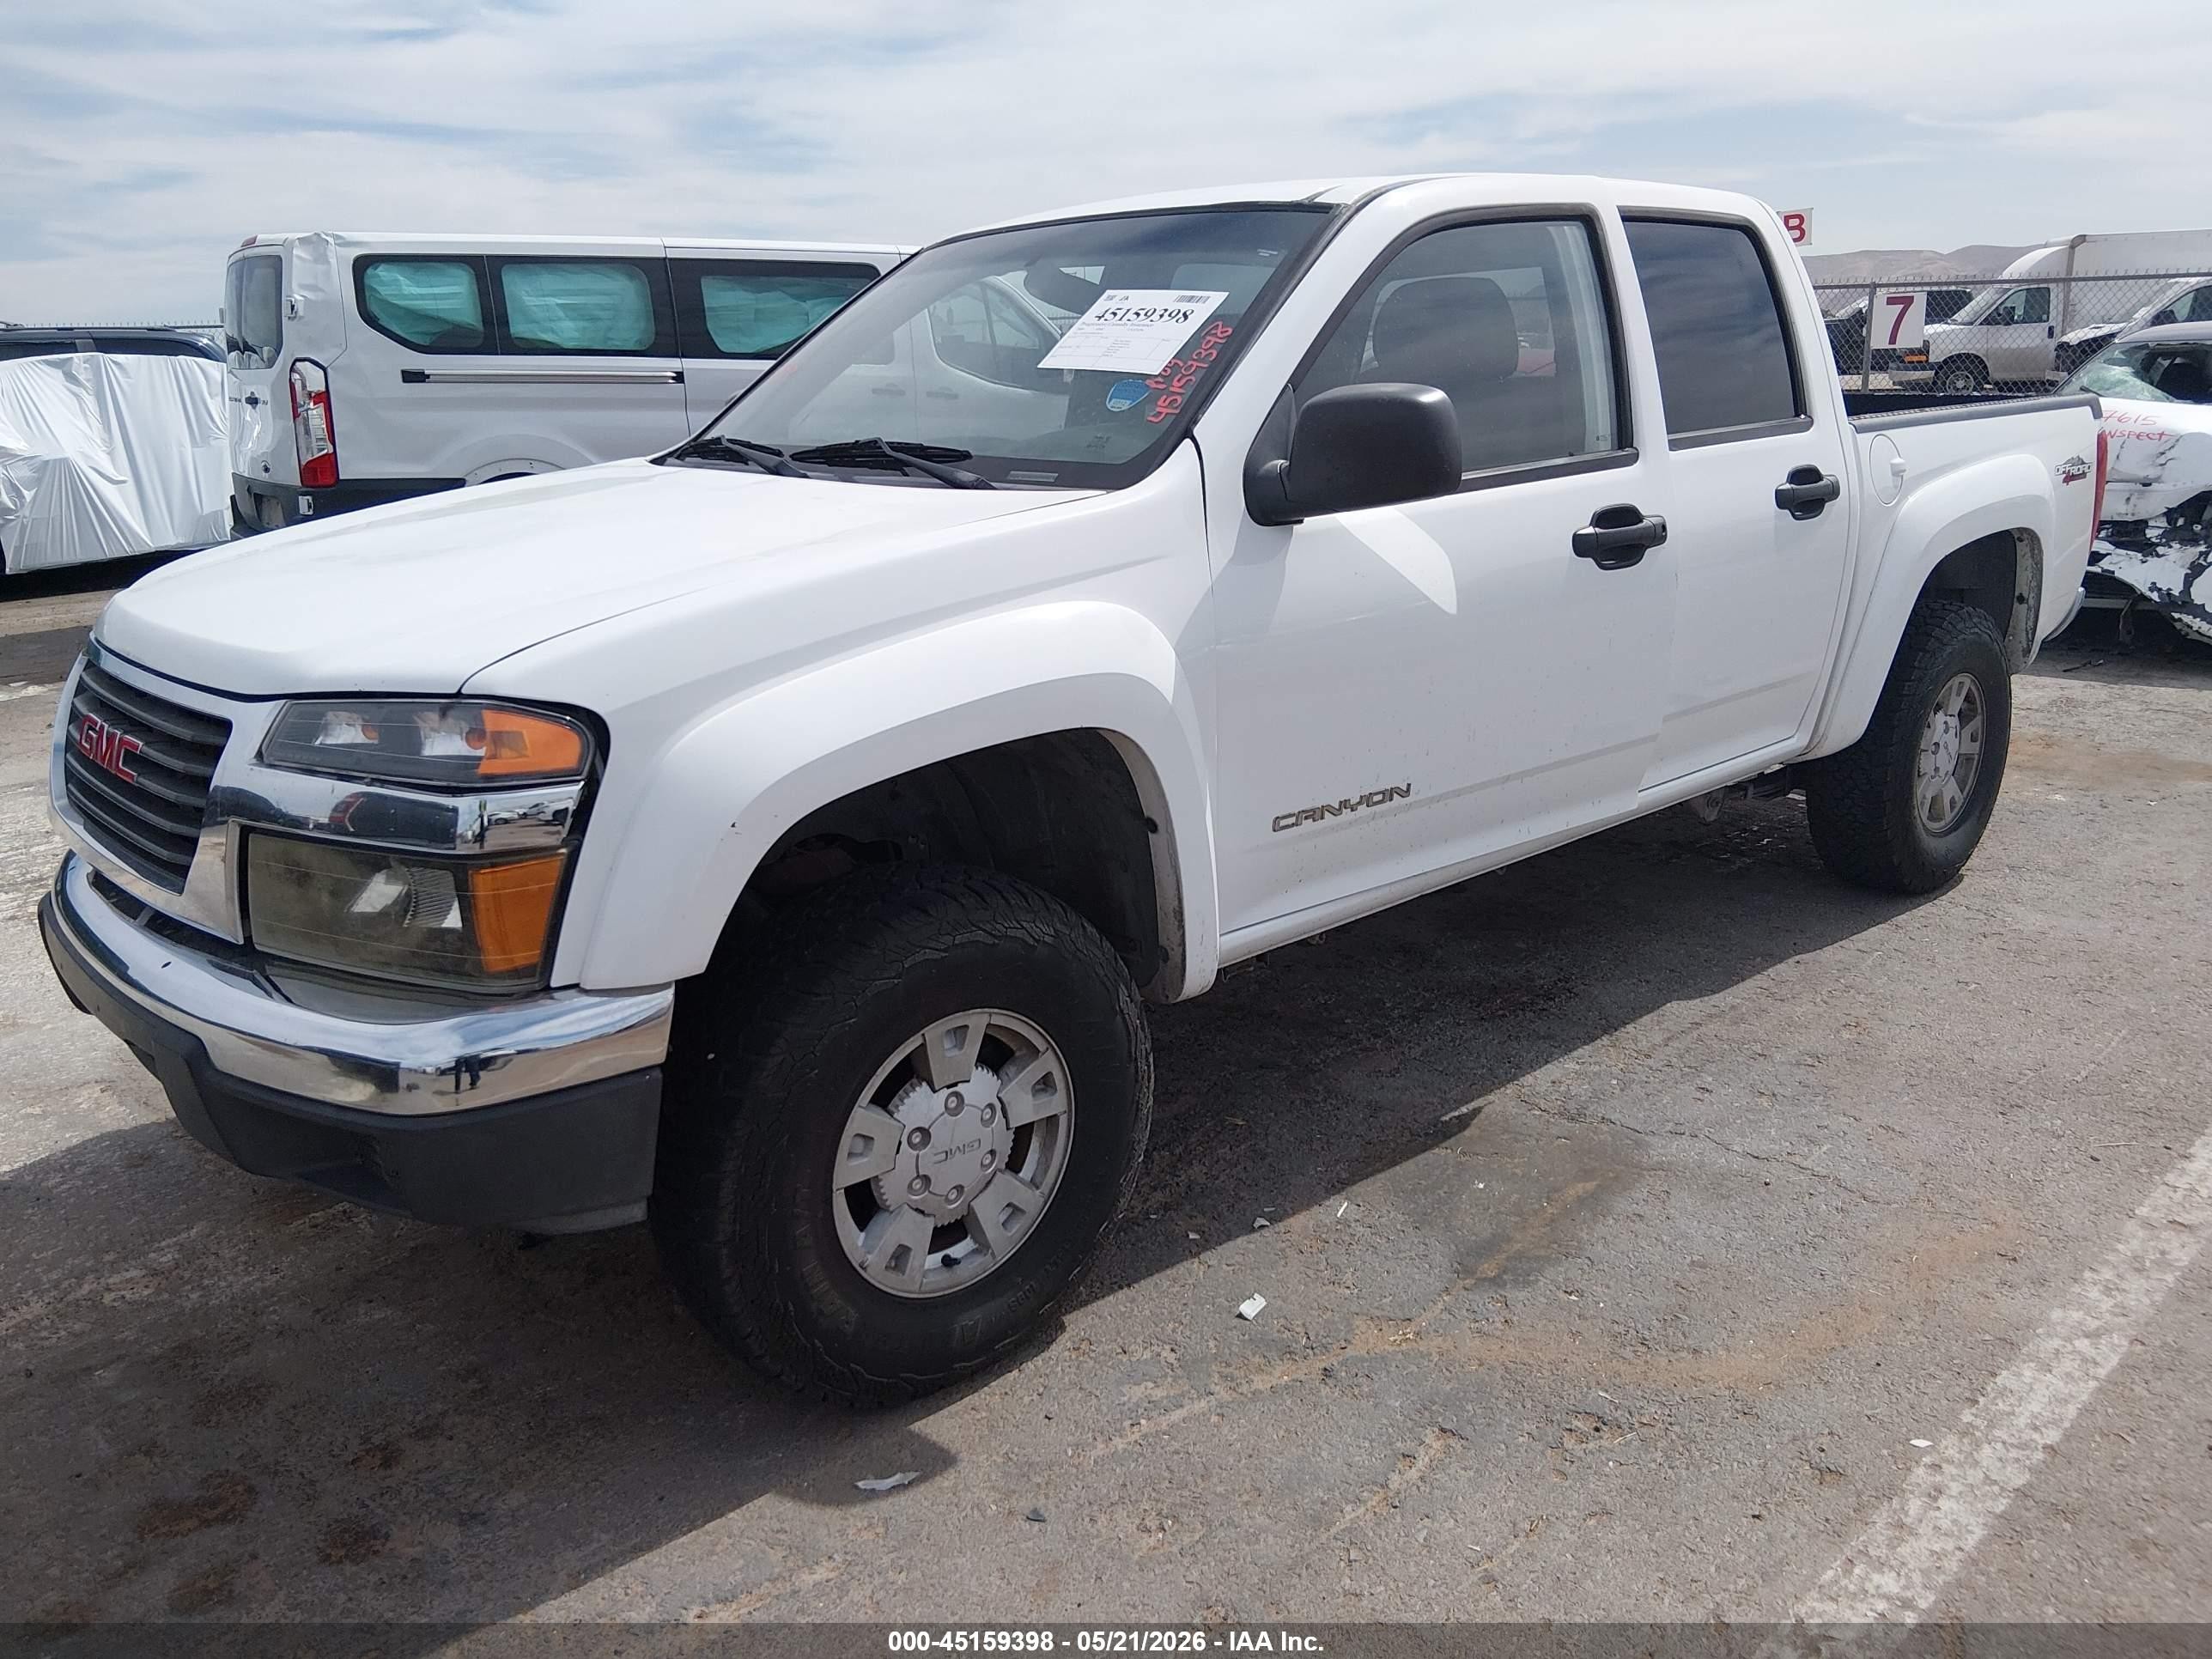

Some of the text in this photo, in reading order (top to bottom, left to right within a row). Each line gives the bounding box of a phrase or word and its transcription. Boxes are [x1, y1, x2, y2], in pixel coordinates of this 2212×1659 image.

[1784, 214, 1806, 243] B
[1094, 307, 1194, 324] 45159398
[1886, 295, 1915, 345] 7
[1146, 321, 1233, 423] 45159398
[79, 713, 144, 783] GMC
[1272, 782, 1412, 833] CANYON
[933, 1138, 981, 1165] GMC
